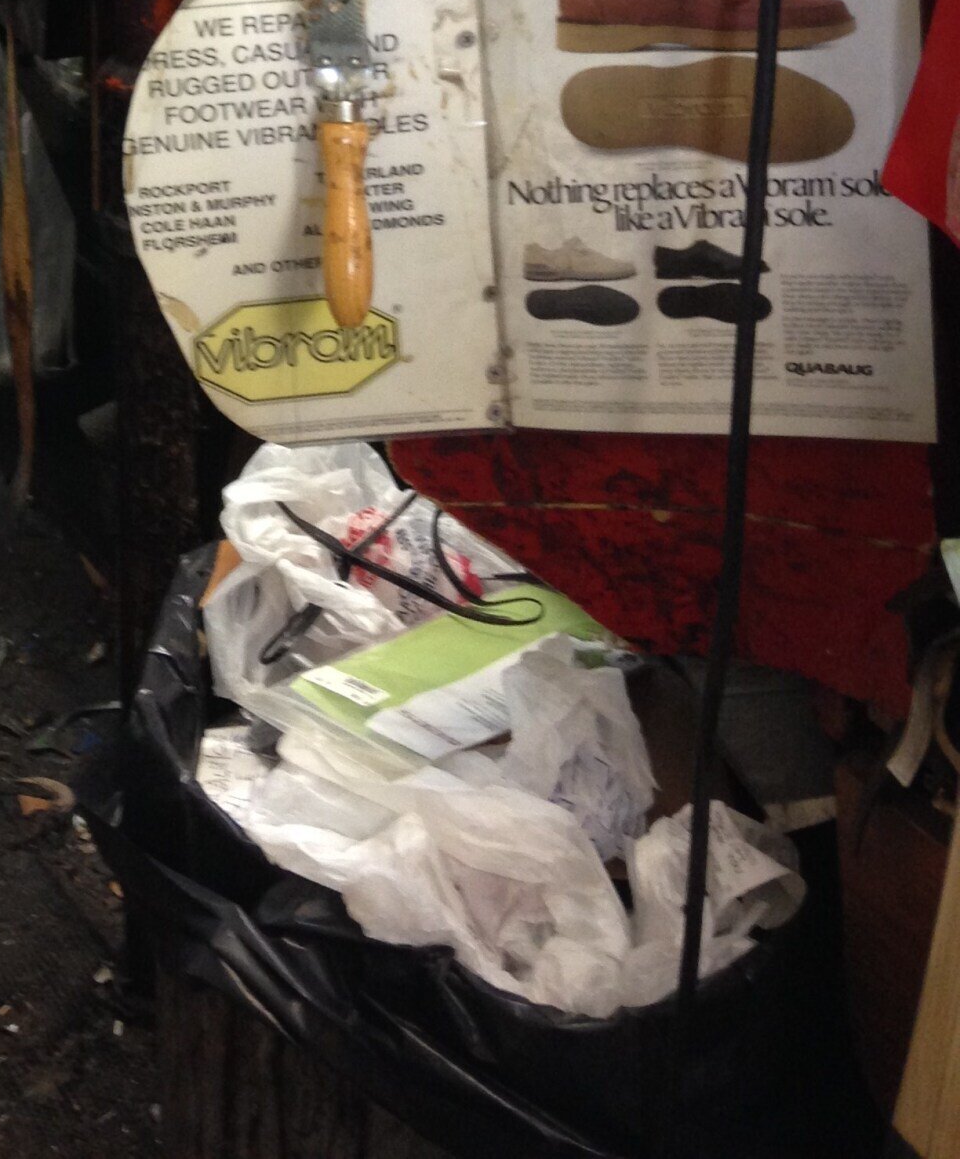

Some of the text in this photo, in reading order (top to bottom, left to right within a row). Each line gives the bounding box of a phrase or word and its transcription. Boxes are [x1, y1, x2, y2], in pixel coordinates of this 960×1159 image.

[193, 13, 310, 38] WE REPA
[232, 40, 310, 66] CASU
[367, 33, 399, 53] ND
[147, 72, 257, 99] RUGGED
[164, 96, 308, 125] FOOTWEAR
[123, 130, 229, 156] GENUINE
[367, 113, 429, 137] OLES
[139, 180, 231, 199] ROCKPORT
[508, 176, 613, 214] Nothing
[613, 173, 716, 211] replaces
[719, 178, 736, 198] a
[735, 173, 836, 199] Vbram
[128, 201, 187, 218] NSTON
[190, 200, 202, 213] &
[205, 194, 277, 211] MURPHY
[140, 198, 415, 235] COLE HAAN WING
[615, 199, 834, 231] like a Vibra sole.
[142, 213, 446, 251] FLORSHEIM DMONDS
[232, 262, 268, 276] AND
[196, 324, 397, 374] vibram
